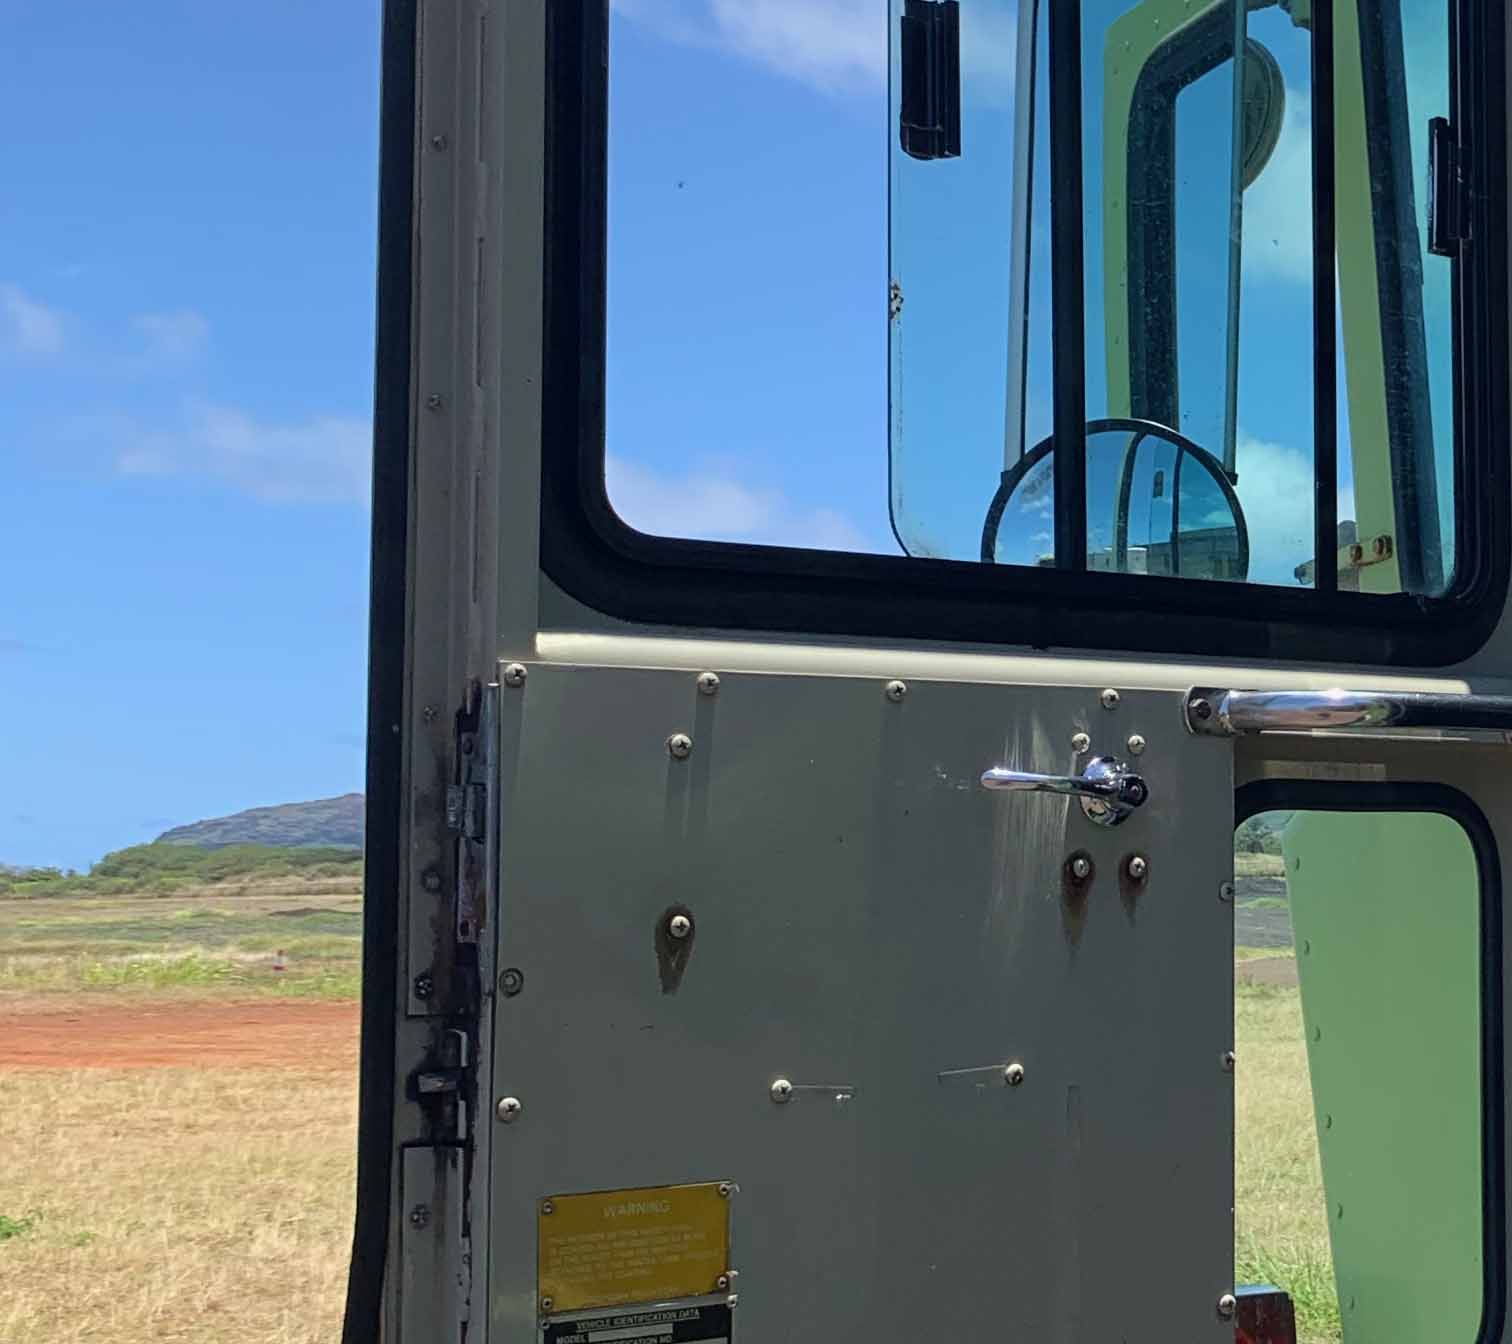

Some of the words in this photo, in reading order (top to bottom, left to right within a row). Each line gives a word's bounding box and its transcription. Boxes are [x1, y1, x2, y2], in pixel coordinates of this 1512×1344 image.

[602, 1199, 672, 1217] WARNING
[577, 1318, 610, 1330] VEHICLE
[613, 1312, 676, 1326] IDENTIFICATION
[679, 1309, 700, 1319] DATA
[556, 1335, 586, 1344] MODEL
